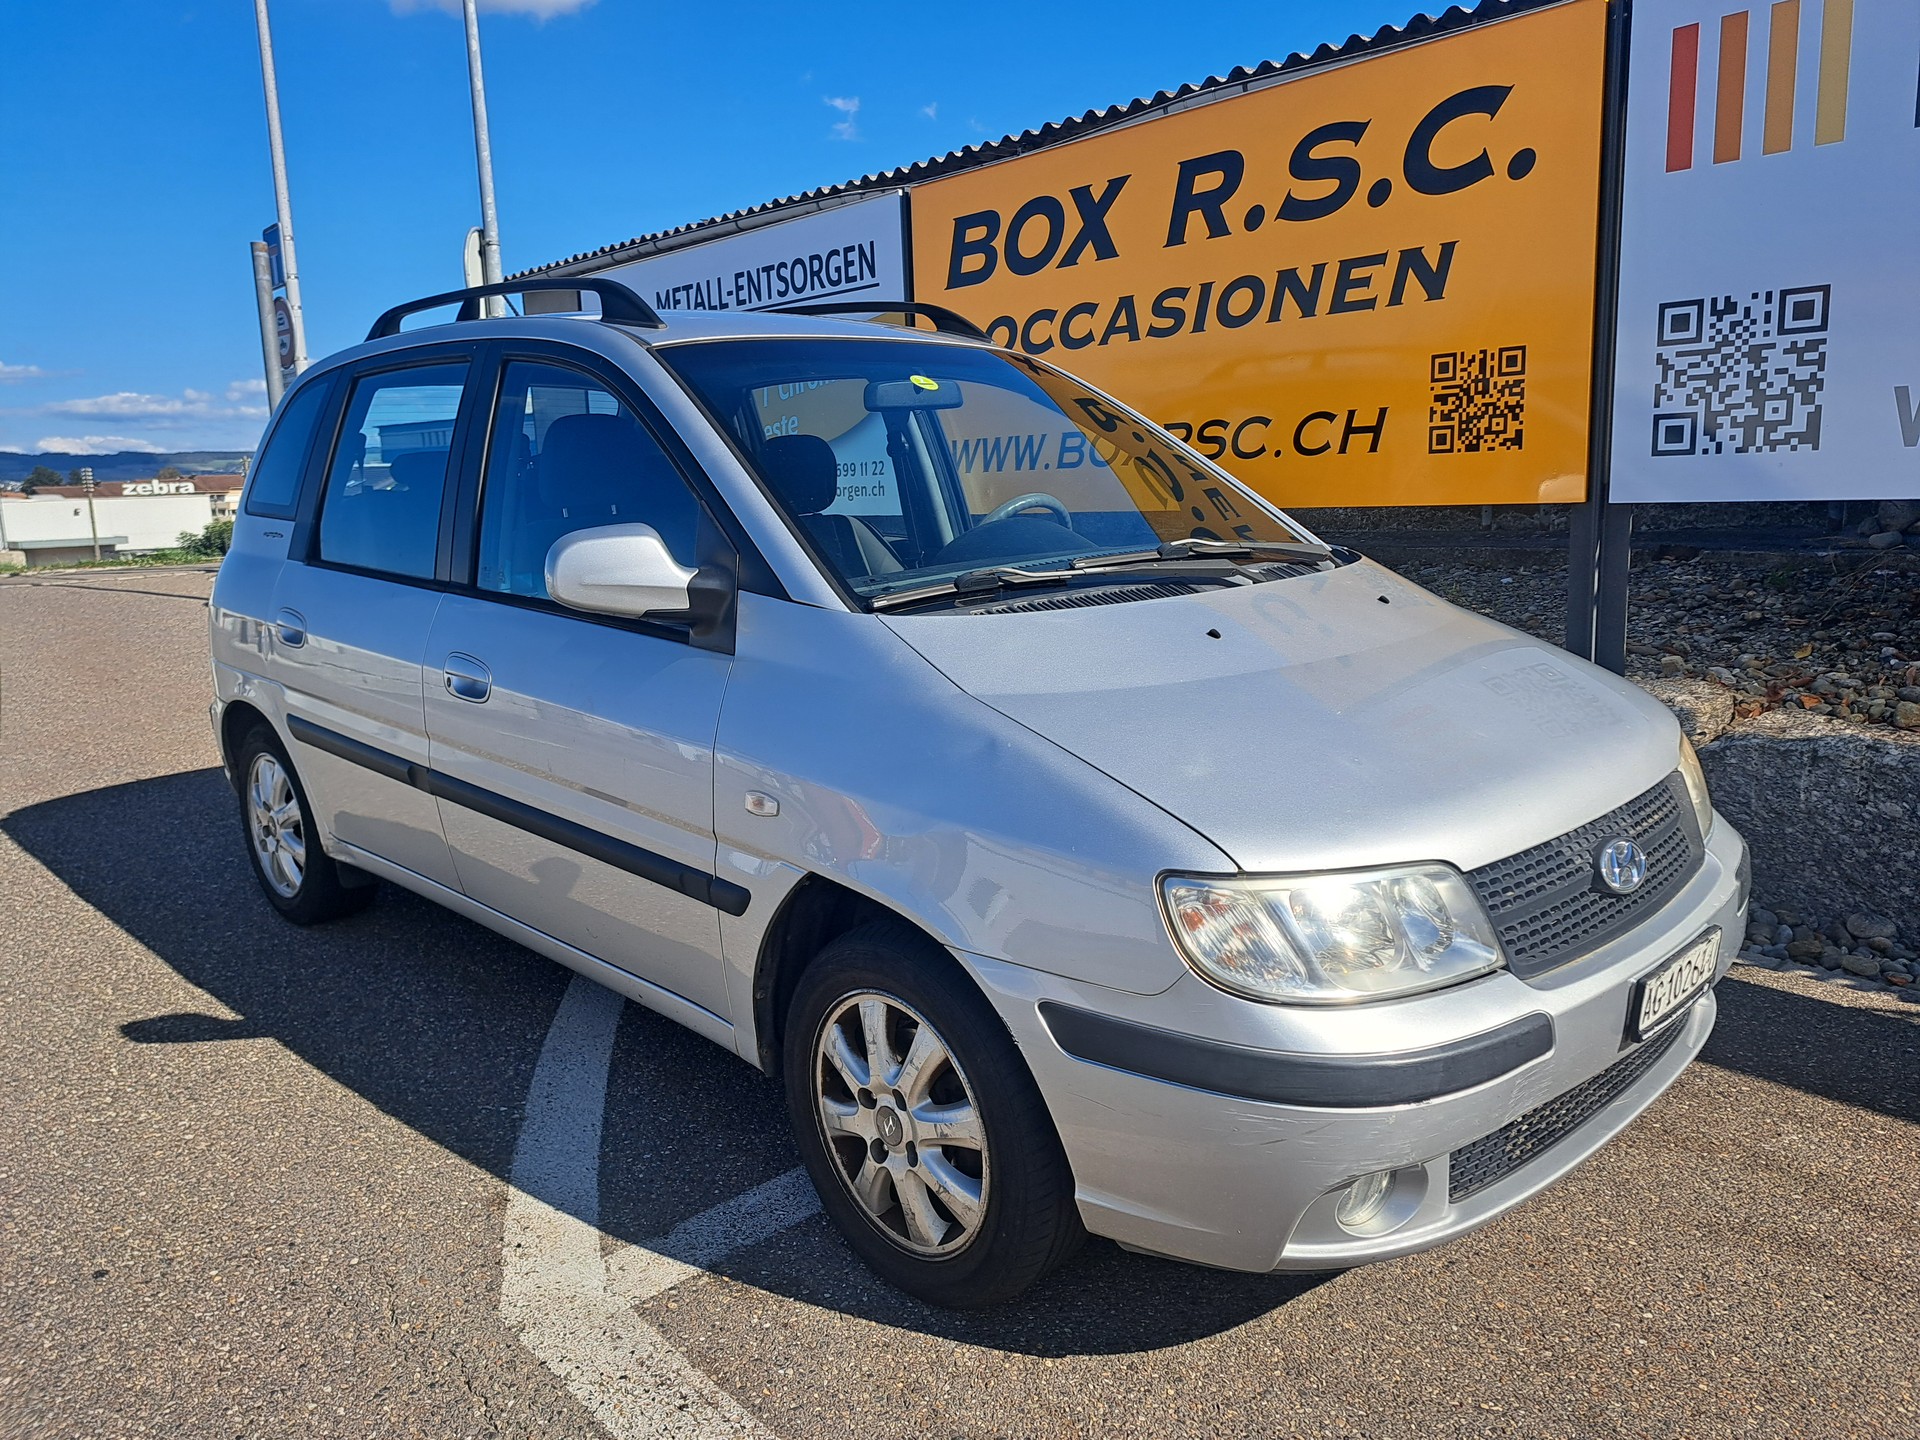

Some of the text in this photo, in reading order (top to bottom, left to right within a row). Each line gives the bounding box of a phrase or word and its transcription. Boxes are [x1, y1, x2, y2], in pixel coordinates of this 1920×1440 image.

[945, 84, 1537, 290] BOX R.S.C.
[655, 240, 876, 311] METALL-ENTSORGEN
[985, 240, 1460, 355] OCCASIONEN
[121, 479, 196, 496] zebra
[860, 461, 868, 477] 11
[871, 460, 885, 476] 22
